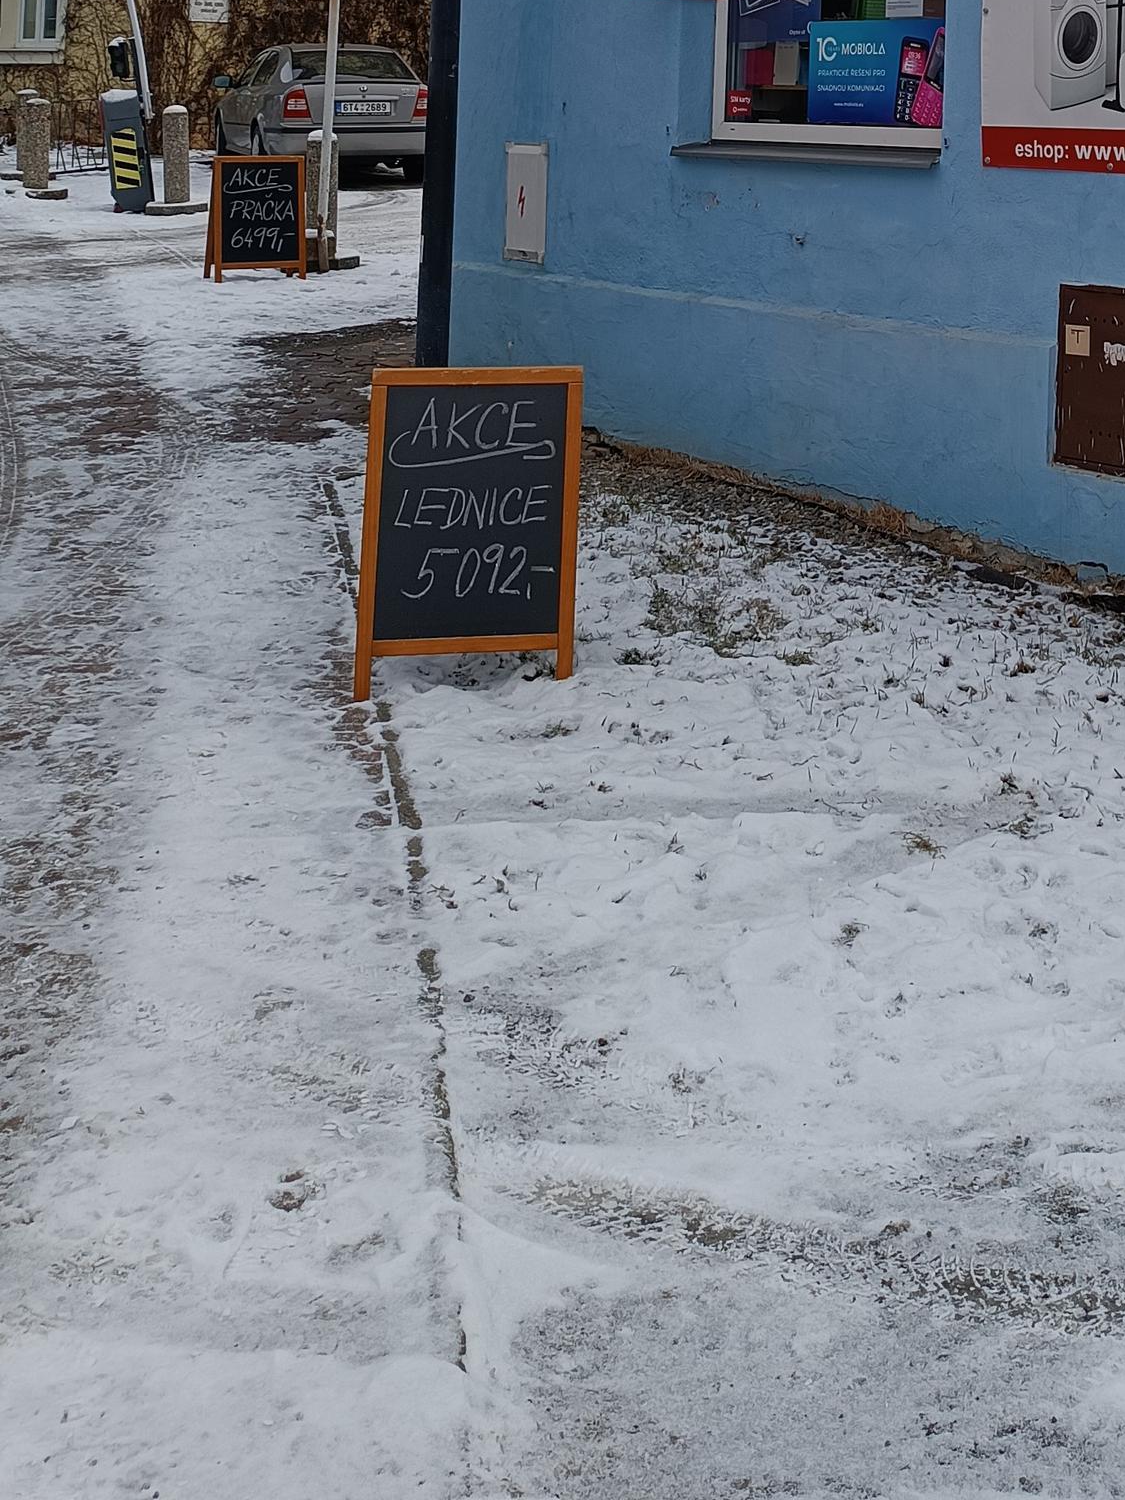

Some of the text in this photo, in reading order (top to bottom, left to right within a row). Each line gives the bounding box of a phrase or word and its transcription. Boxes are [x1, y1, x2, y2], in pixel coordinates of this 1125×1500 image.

[841, 42, 886, 55] MOBIOLA
[817, 68, 849, 77] PRAKTICKÉ
[817, 84, 846, 92] SNADNOU
[1014, 141, 1070, 161] eshop:
[229, 168, 282, 187] AKCE
[230, 193, 295, 221] PRAČKA
[410, 397, 536, 450] AKCE
[394, 485, 552, 530] LEDNICE
